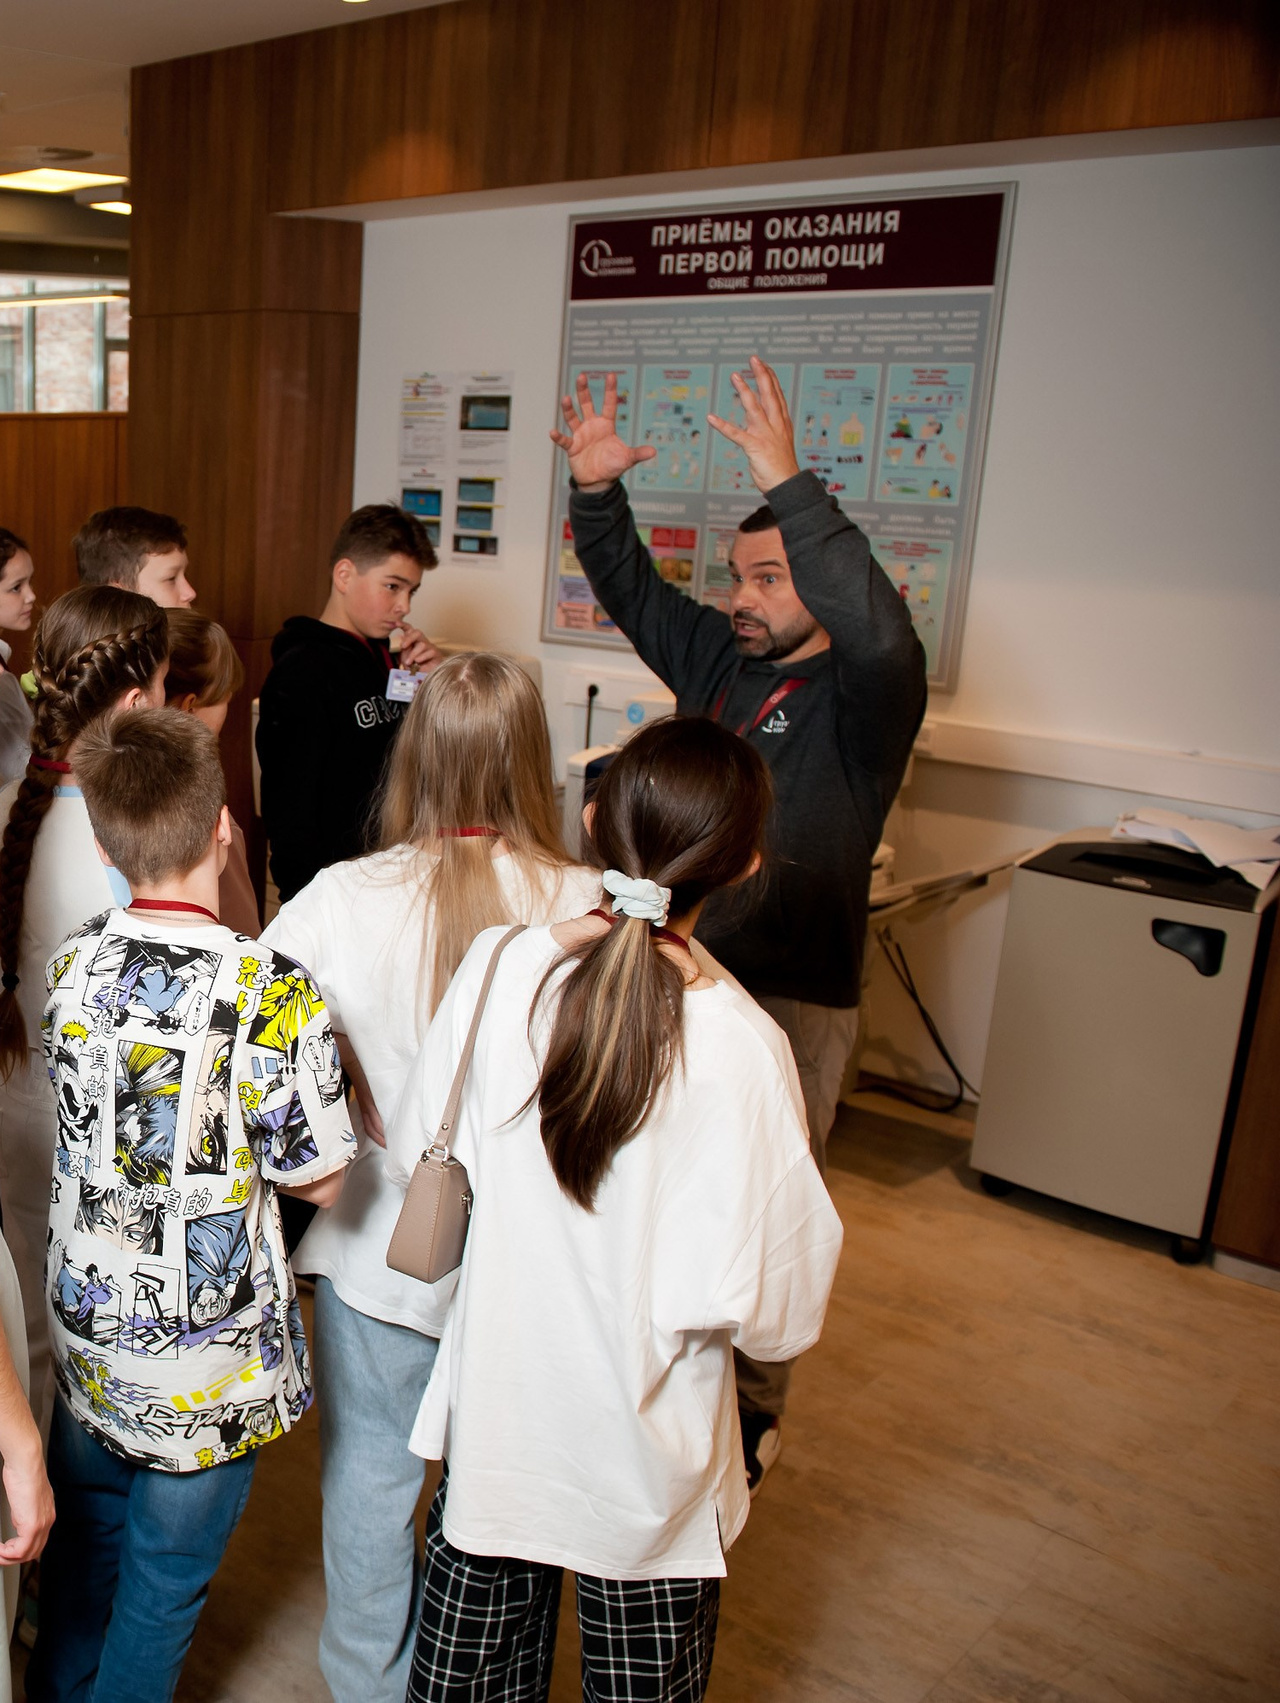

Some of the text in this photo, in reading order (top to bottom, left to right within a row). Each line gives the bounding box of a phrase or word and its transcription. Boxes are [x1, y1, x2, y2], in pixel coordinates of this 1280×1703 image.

[651, 210, 901, 247] ПРИЁМЫ ОКАЗАНИЯ
[659, 242, 885, 275] ПЕРВОЙ ПОМОЩИ
[707, 273, 828, 290] ОБЩИЕ ПОЛОЖЕНИЯ
[135, 1398, 269, 1439] REPEAT
